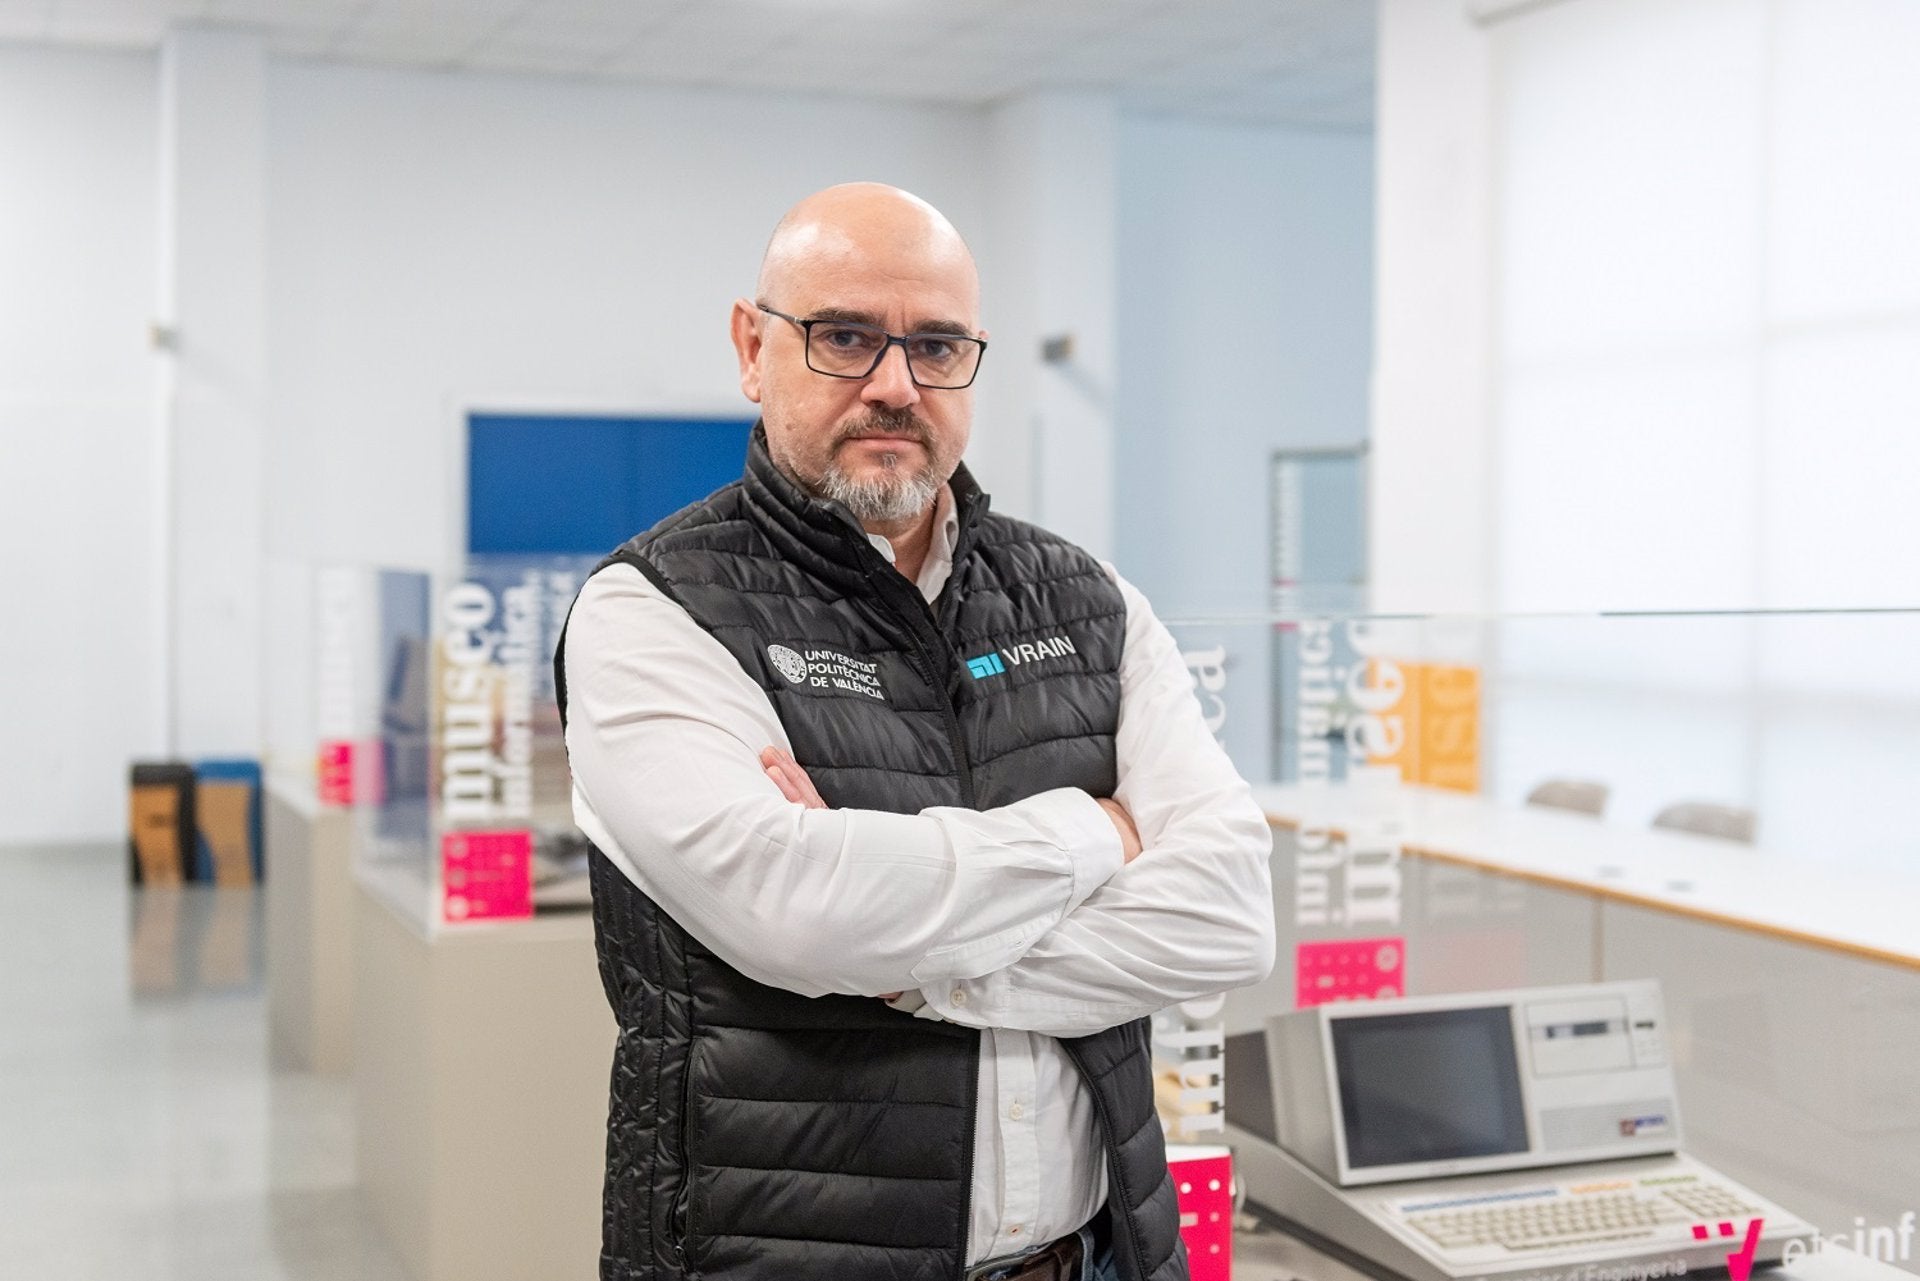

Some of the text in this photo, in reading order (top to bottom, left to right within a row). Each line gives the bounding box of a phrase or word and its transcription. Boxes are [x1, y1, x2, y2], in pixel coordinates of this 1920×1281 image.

[804, 650, 877, 674] UNIVERSITAT
[1001, 635, 1076, 666] VRAIN
[810, 676, 829, 688] DE
[444, 582, 495, 819] museo
[1782, 1211, 1916, 1270] etinf
